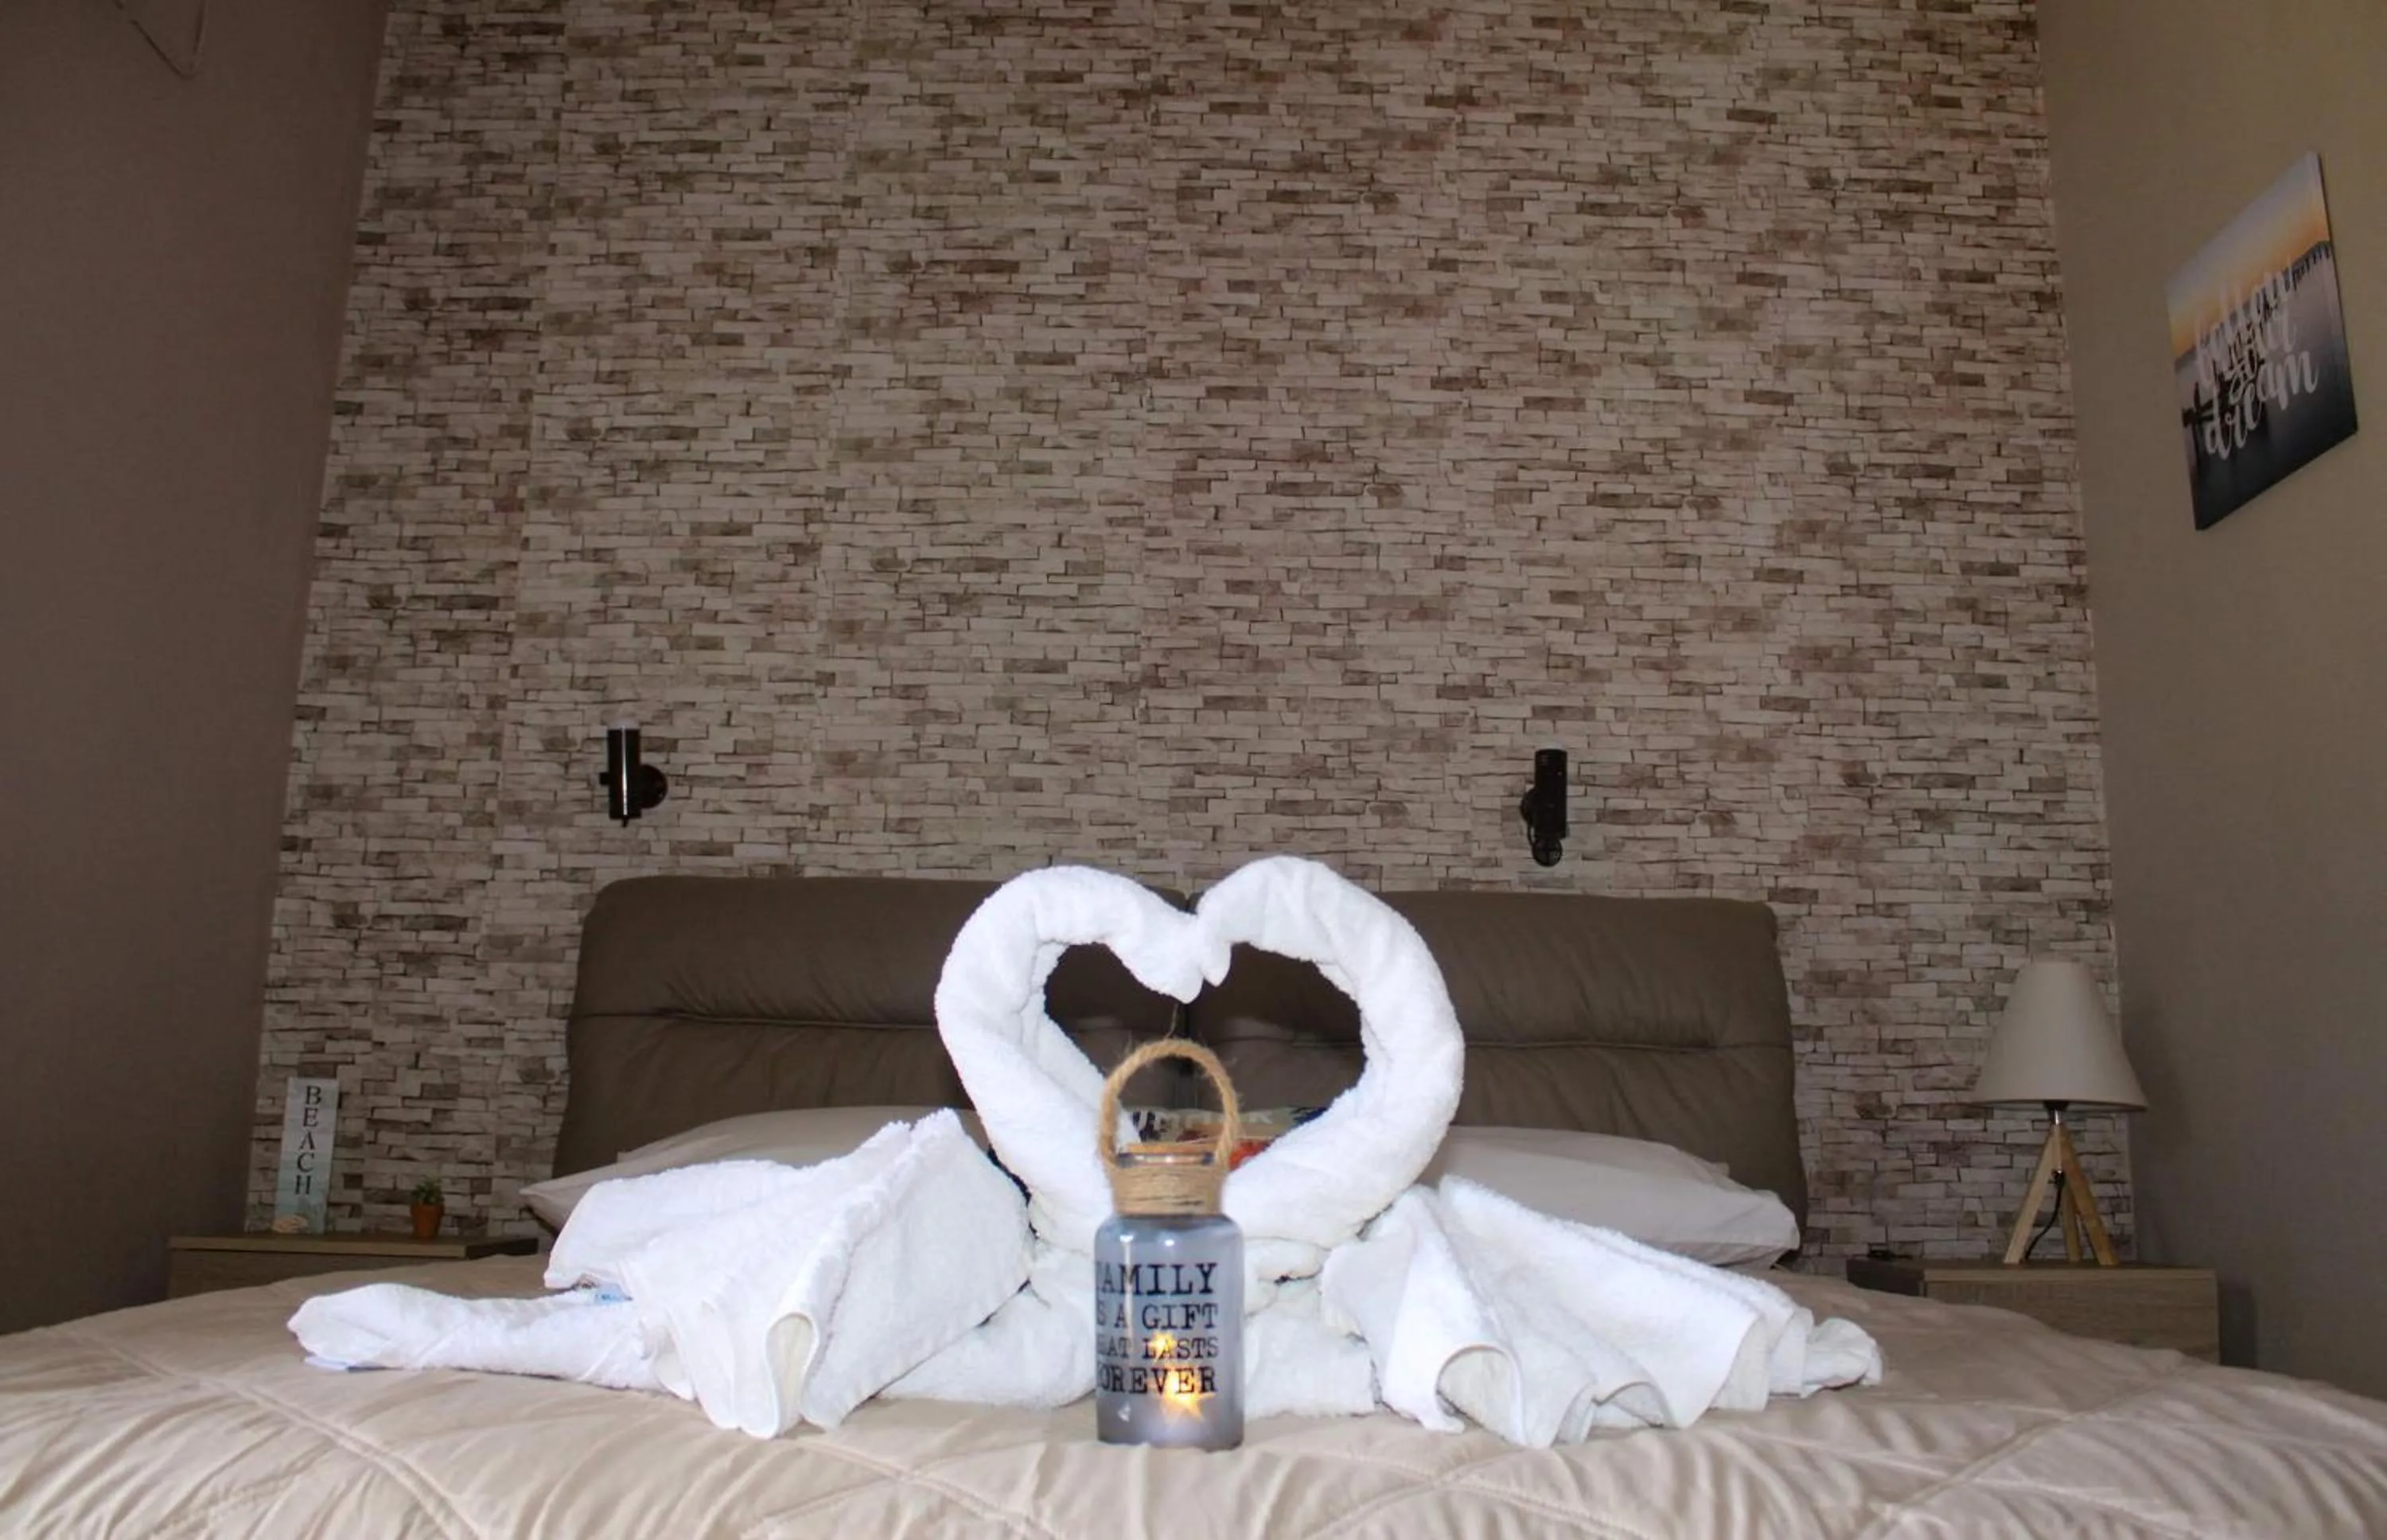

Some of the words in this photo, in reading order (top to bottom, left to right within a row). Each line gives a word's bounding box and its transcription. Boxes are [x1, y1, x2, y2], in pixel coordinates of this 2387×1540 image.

[2204, 350, 2319, 460] dream
[295, 1085, 321, 1195] BEACH
[1115, 1304, 1128, 1328] A
[1142, 1302, 1217, 1329] GIFT
[1143, 1336, 1219, 1360] LASTS
